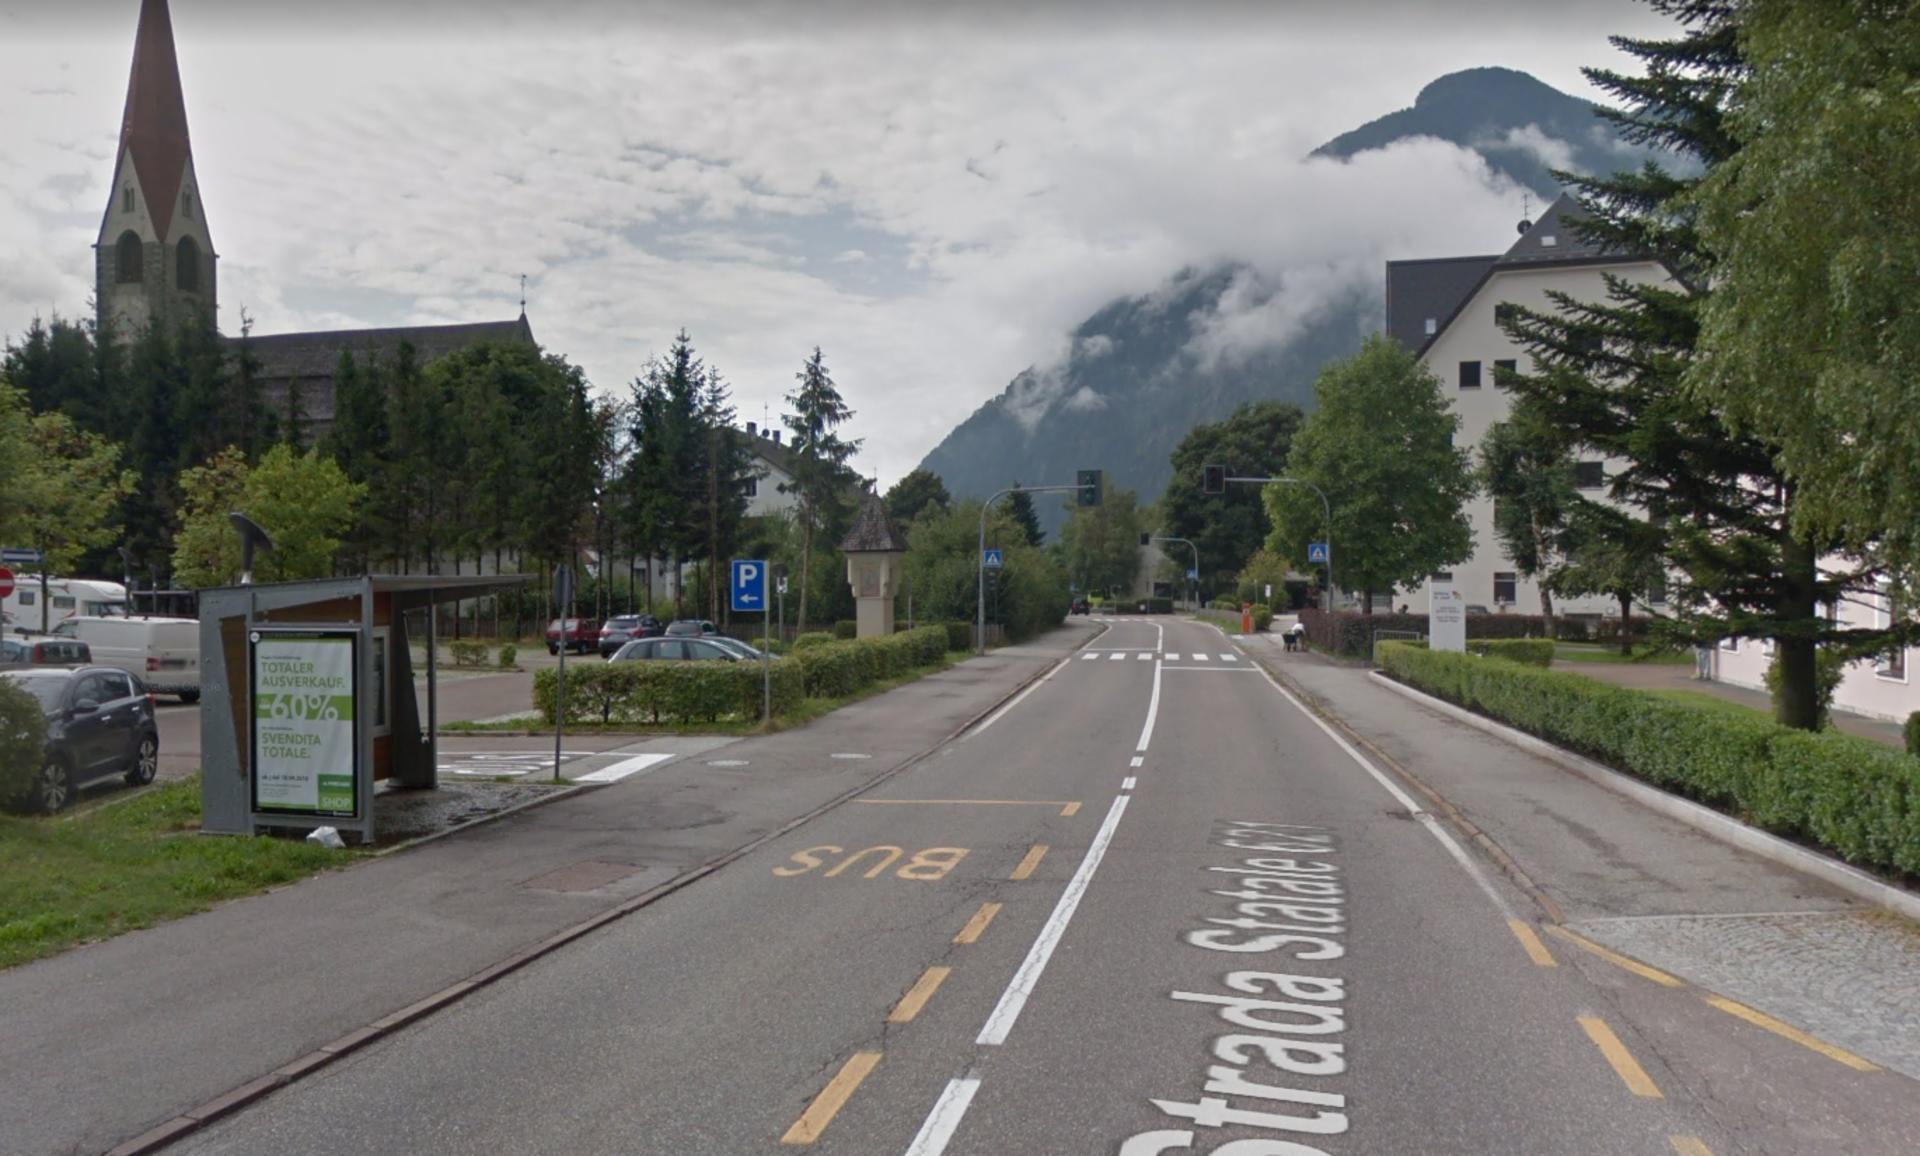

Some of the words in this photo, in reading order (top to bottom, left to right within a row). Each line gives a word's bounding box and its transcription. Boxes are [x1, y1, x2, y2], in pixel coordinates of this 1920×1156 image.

[740, 565, 757, 588] P
[262, 662, 314, 673] TOTALER
[262, 675, 345, 689] AUSVERKAUF.
[259, 691, 339, 720] -60%
[262, 732, 321, 745] SVENDITA
[262, 746, 311, 758] TOTALE.
[322, 797, 350, 808] SHOP
[772, 845, 971, 880] BUS
